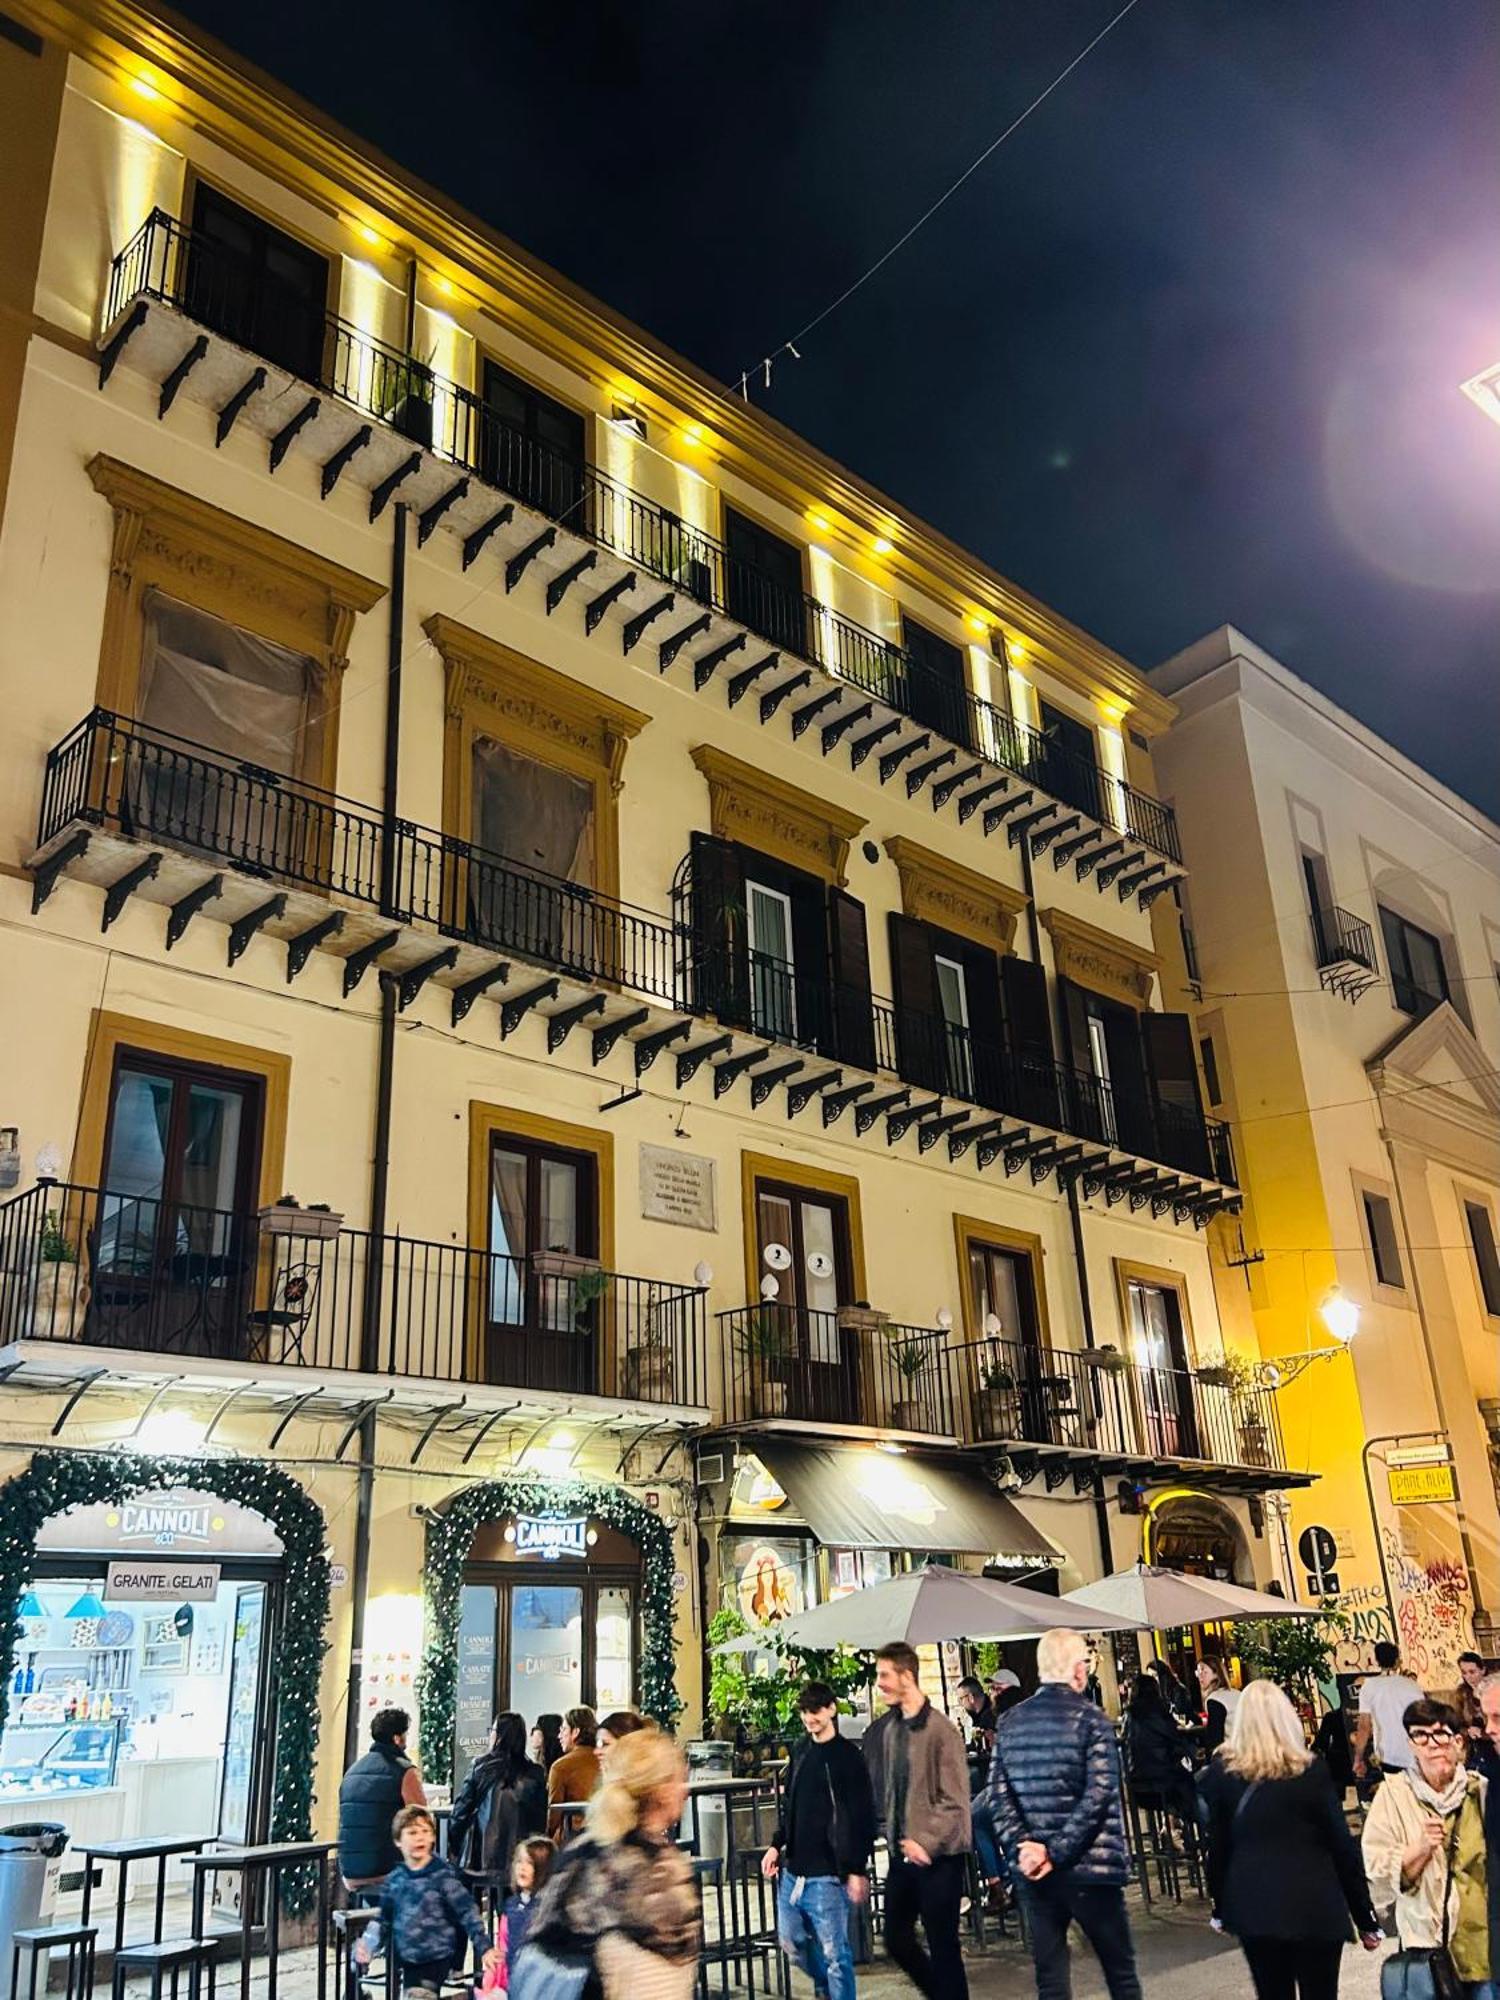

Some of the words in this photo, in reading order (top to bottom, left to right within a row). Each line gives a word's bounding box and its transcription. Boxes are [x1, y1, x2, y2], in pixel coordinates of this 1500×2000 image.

[122, 1506, 210, 1537] CANNOLI
[517, 1521, 586, 1550] CANNOLI
[113, 1574, 166, 1588] GRANITE
[172, 1575, 213, 1589] GELATI
